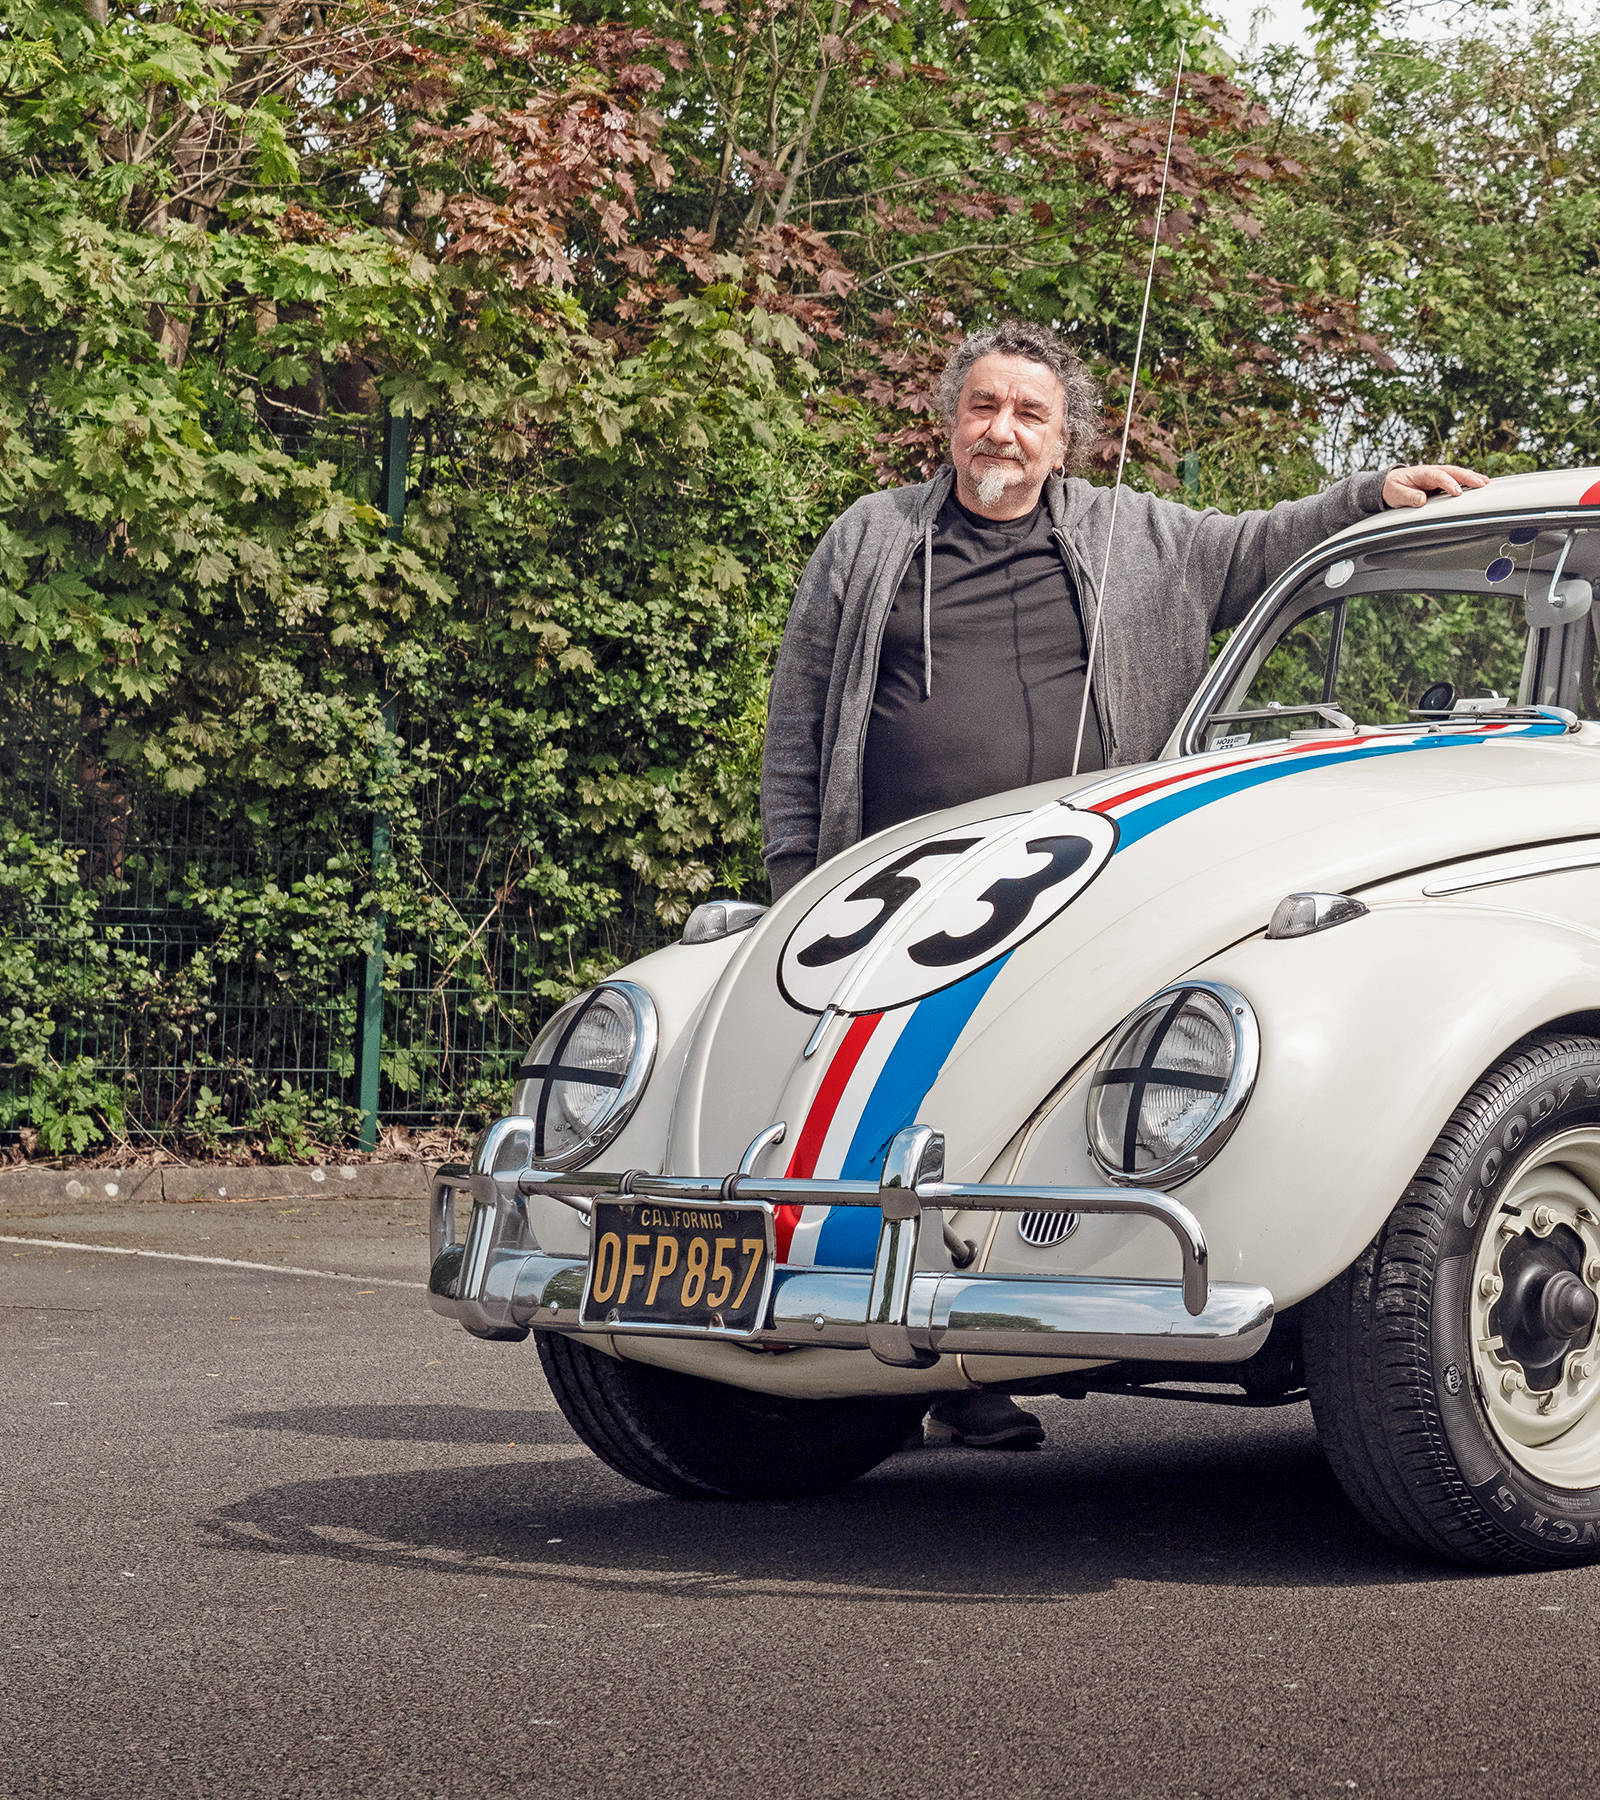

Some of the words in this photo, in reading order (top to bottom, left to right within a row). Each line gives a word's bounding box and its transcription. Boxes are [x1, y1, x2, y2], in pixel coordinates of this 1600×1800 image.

[797, 835, 1092, 967] 53
[641, 1208, 723, 1230] CALIFORNIA
[680, 1236, 764, 1310] 857
[1490, 1485, 1518, 1513] 5
